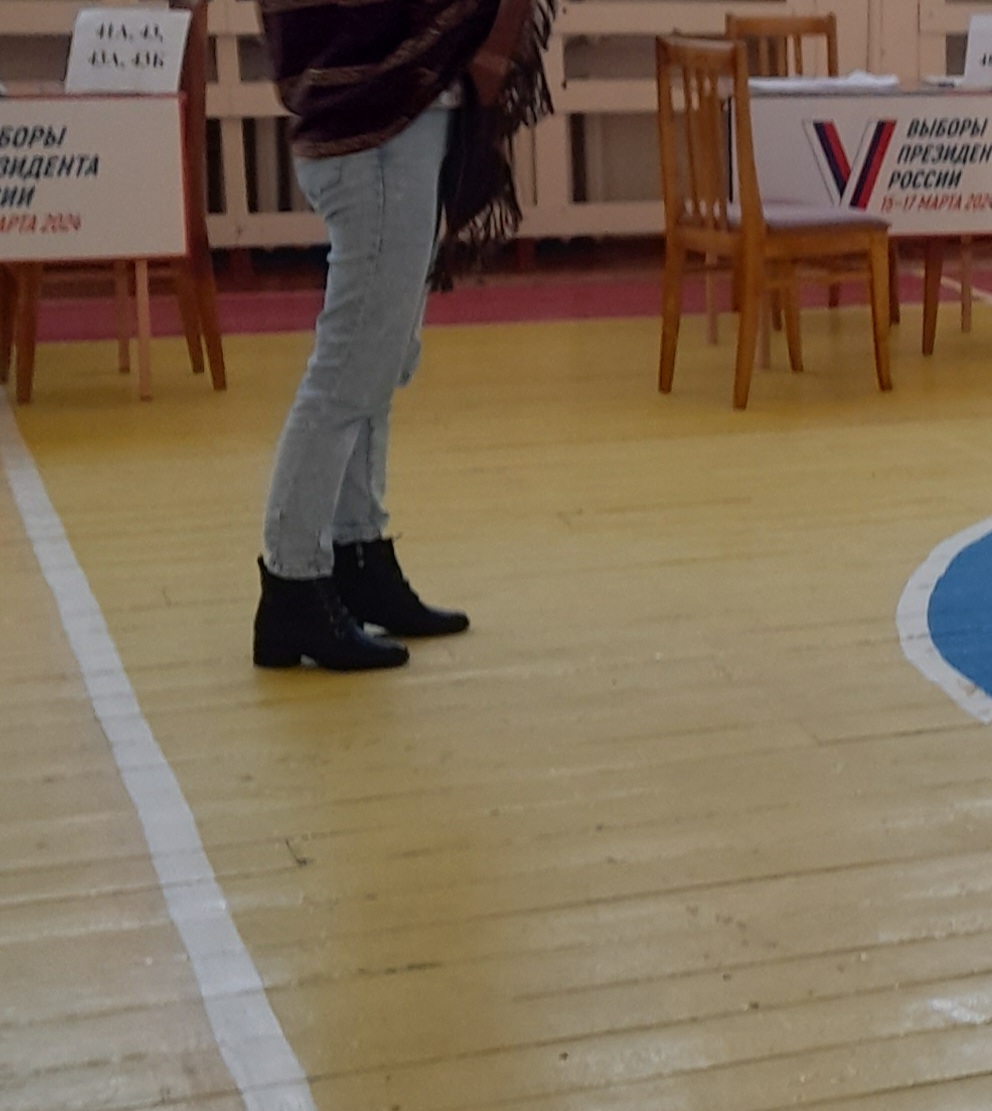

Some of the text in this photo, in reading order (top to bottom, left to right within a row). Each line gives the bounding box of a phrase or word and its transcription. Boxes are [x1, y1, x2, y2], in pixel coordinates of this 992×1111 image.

[907, 118, 989, 138] ВЫБОРЫ
[888, 169, 962, 189] РОССИИ
[918, 193, 962, 210] МАРТА
